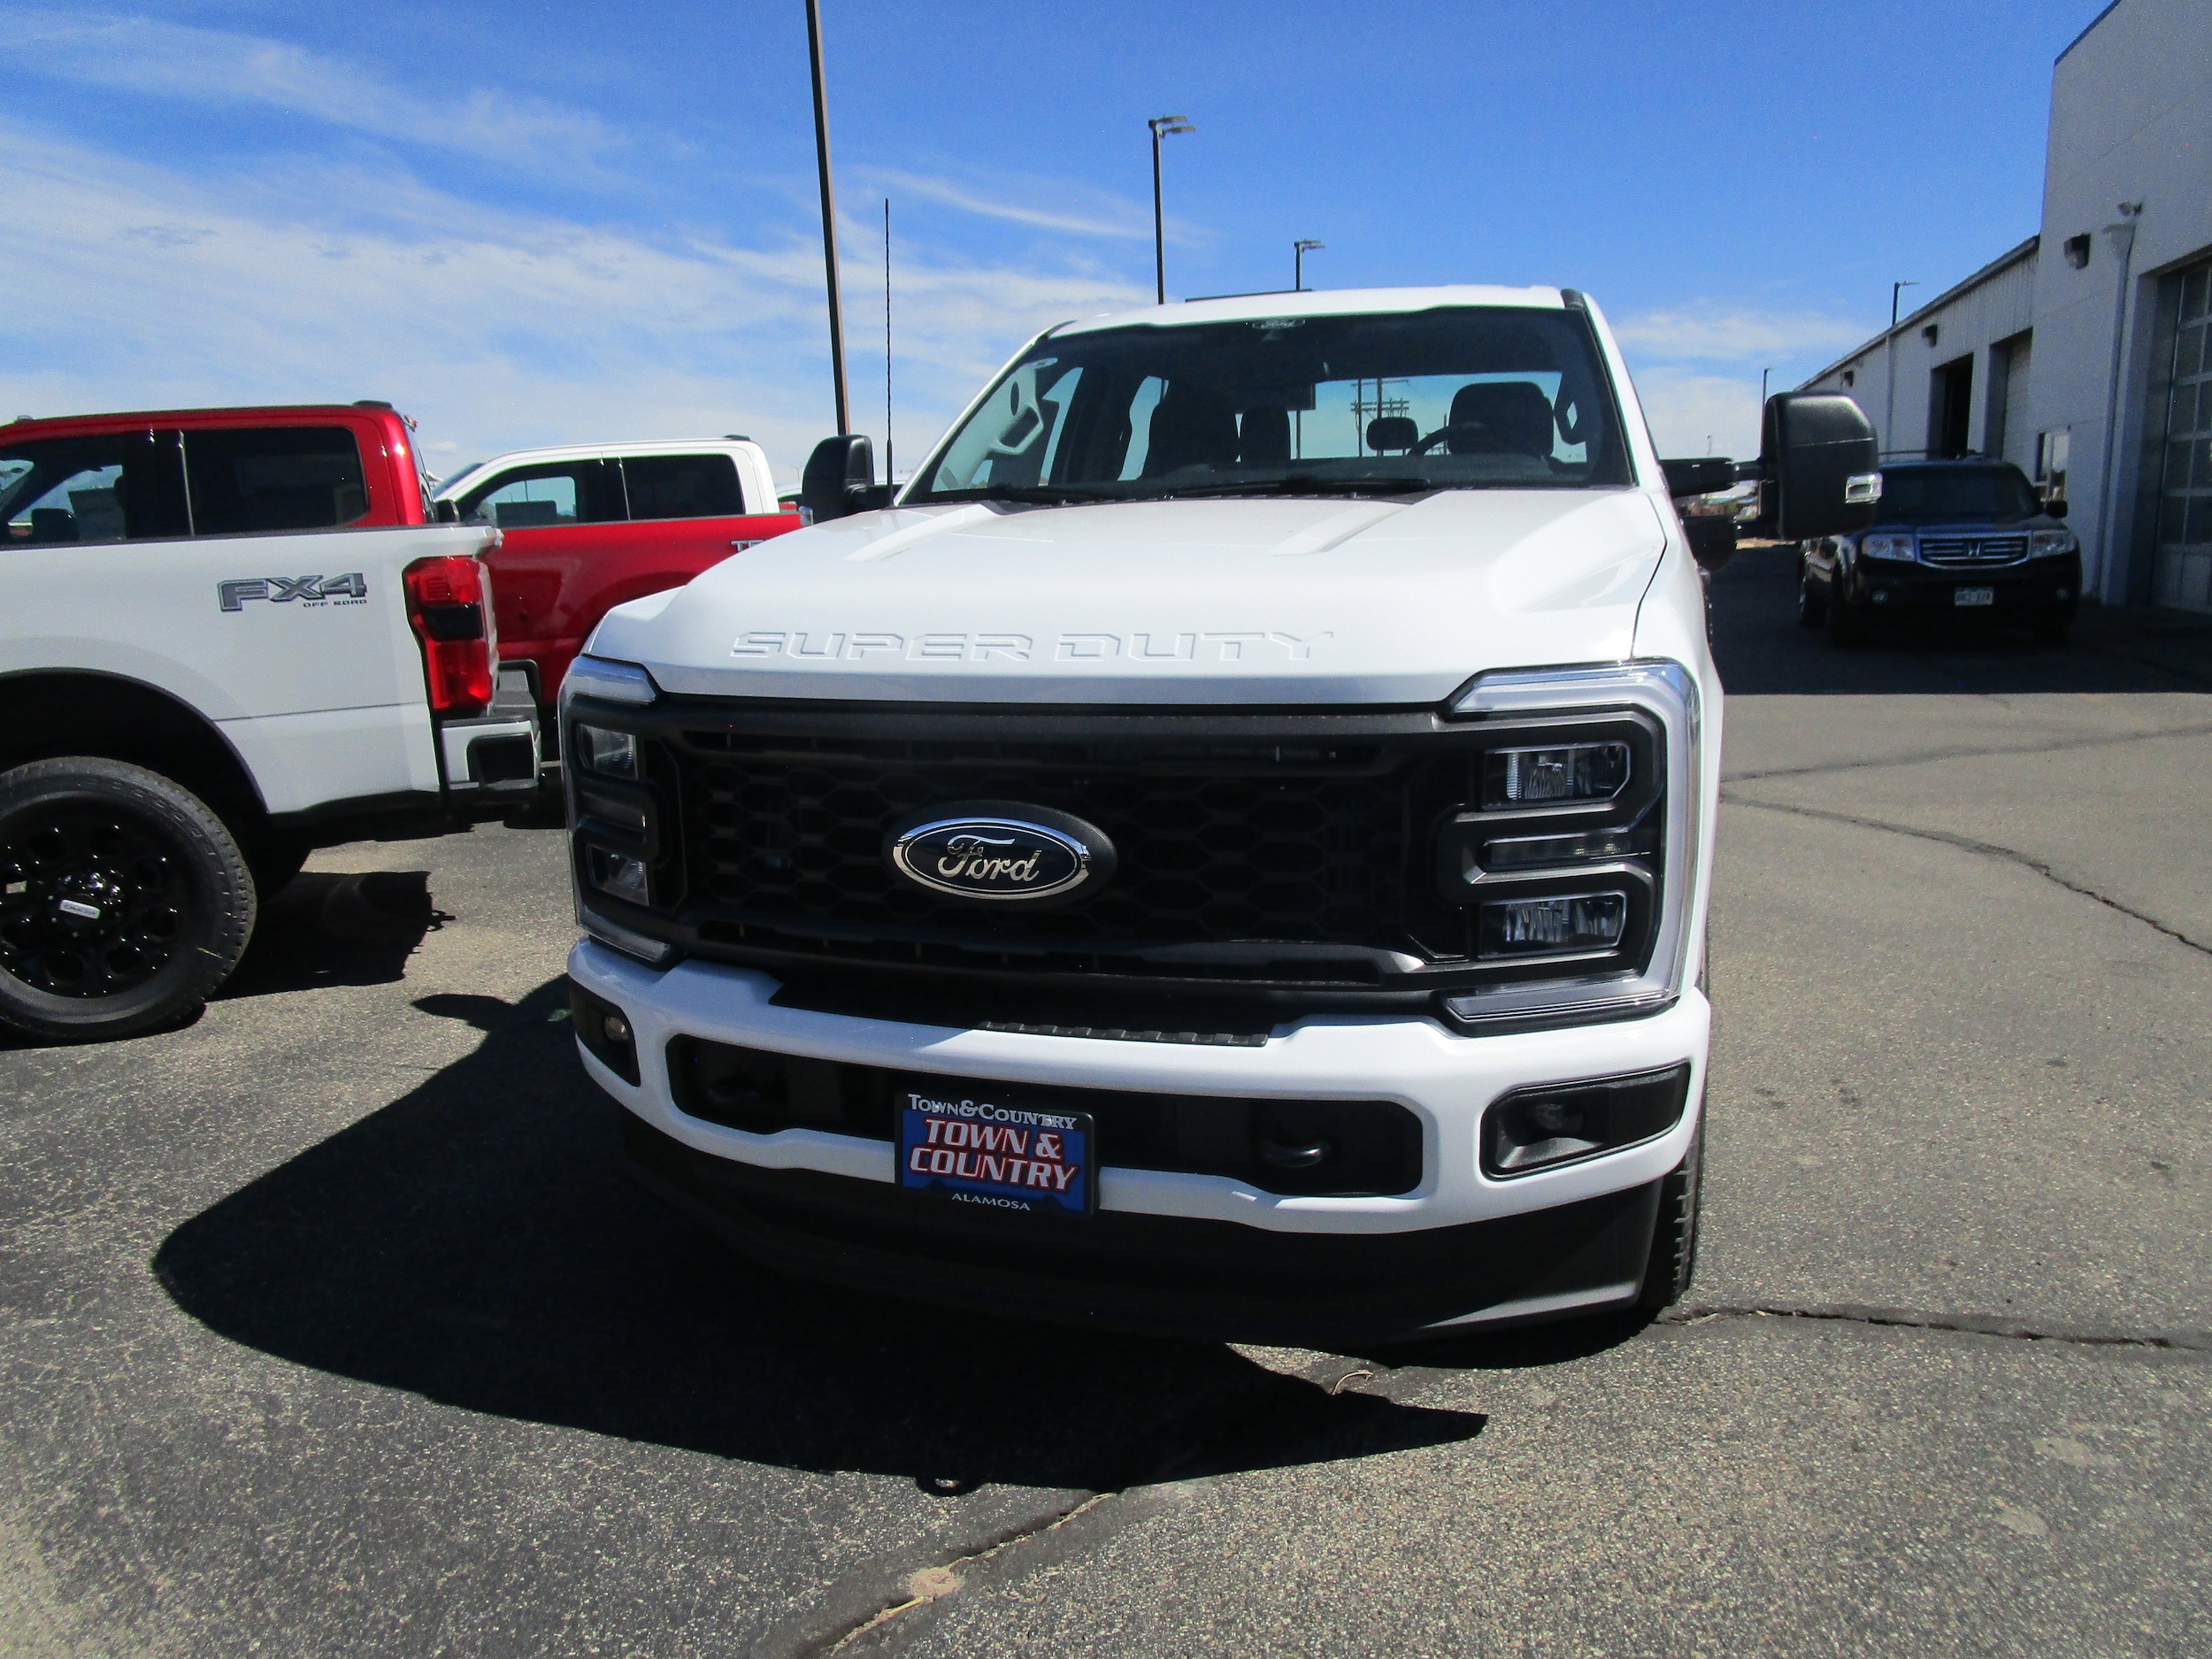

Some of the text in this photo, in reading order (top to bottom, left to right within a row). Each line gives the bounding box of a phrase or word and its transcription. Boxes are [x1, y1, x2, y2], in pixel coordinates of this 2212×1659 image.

[217, 572, 367, 611] FX4
[333, 598, 367, 607] ROAD
[729, 631, 1333, 662] SUPER DUTY
[937, 834, 1042, 882] Ford
[926, 1118, 1061, 1160] TOWN &
[910, 1147, 1078, 1191] COUNTRY
[951, 1192, 1031, 1211] ALAMOSA
